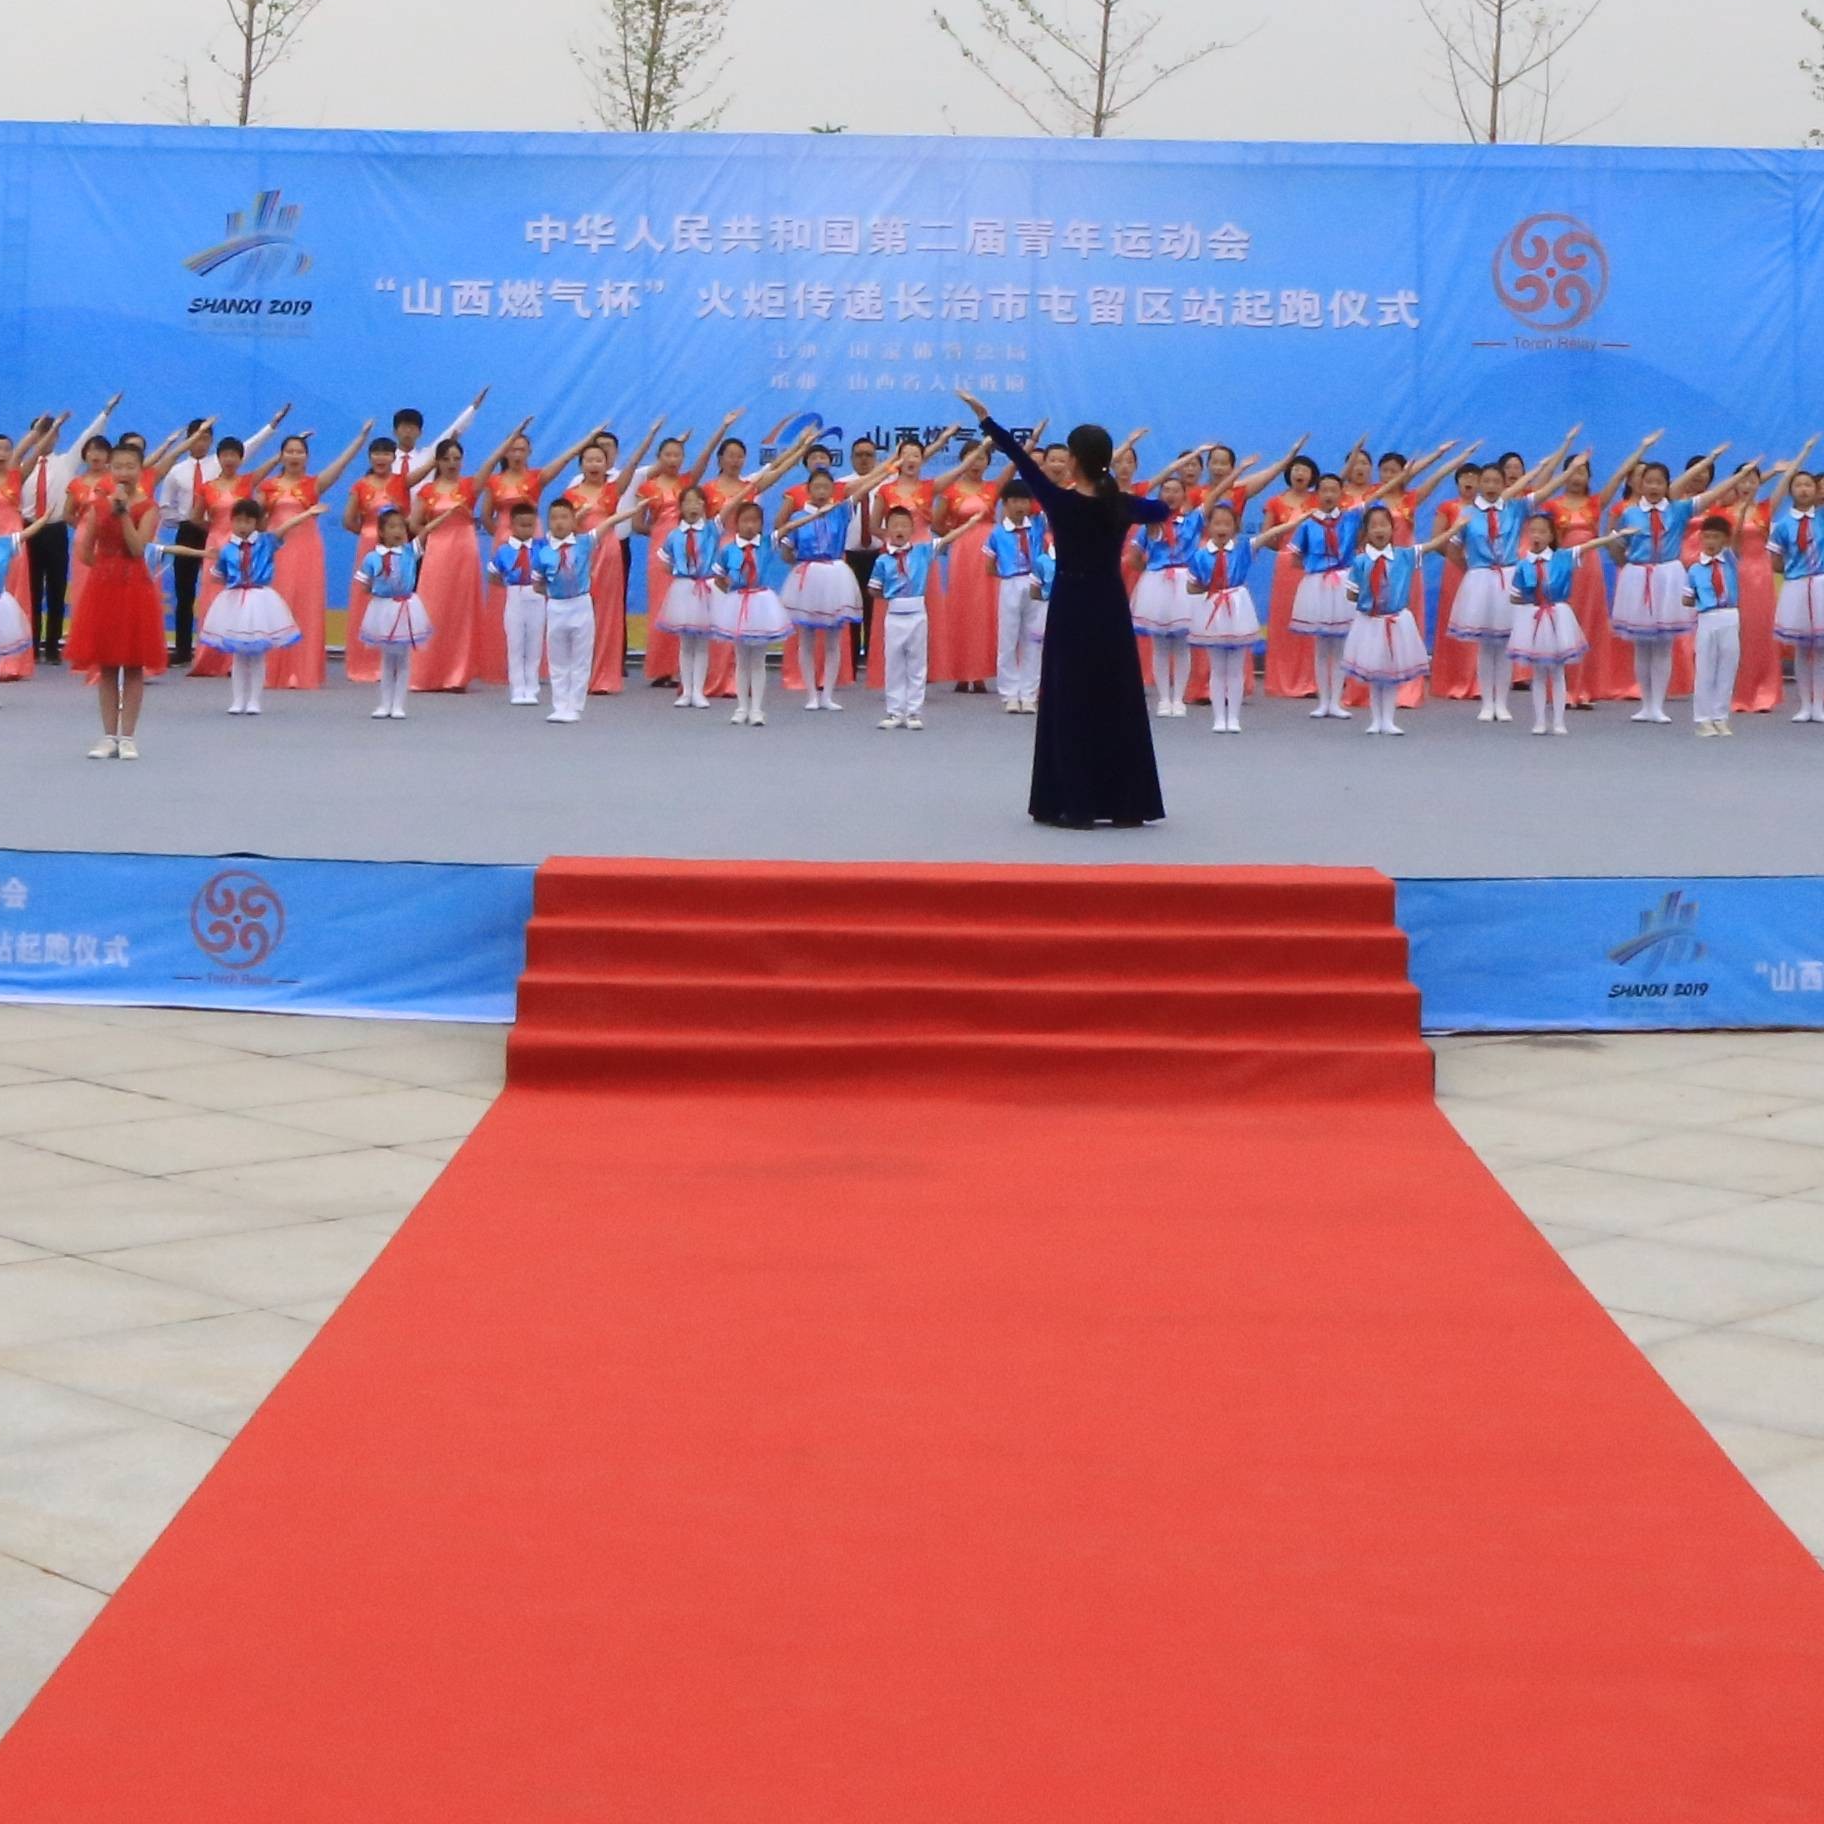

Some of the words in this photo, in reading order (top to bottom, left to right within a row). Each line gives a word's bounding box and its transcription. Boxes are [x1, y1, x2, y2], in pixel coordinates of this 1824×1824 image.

[525, 213, 1252, 262] 中华人民共和国第二届青年运动会
[187, 297, 263, 314] SHANXI
[268, 299, 313, 316] 2019
[696, 279, 1422, 330] 火炬传递长治市屯留区站起跑仪式
[866, 425, 1034, 453] 山西燃气团
[1608, 983, 1669, 999] SHANXI
[1674, 982, 1709, 997] 2019
